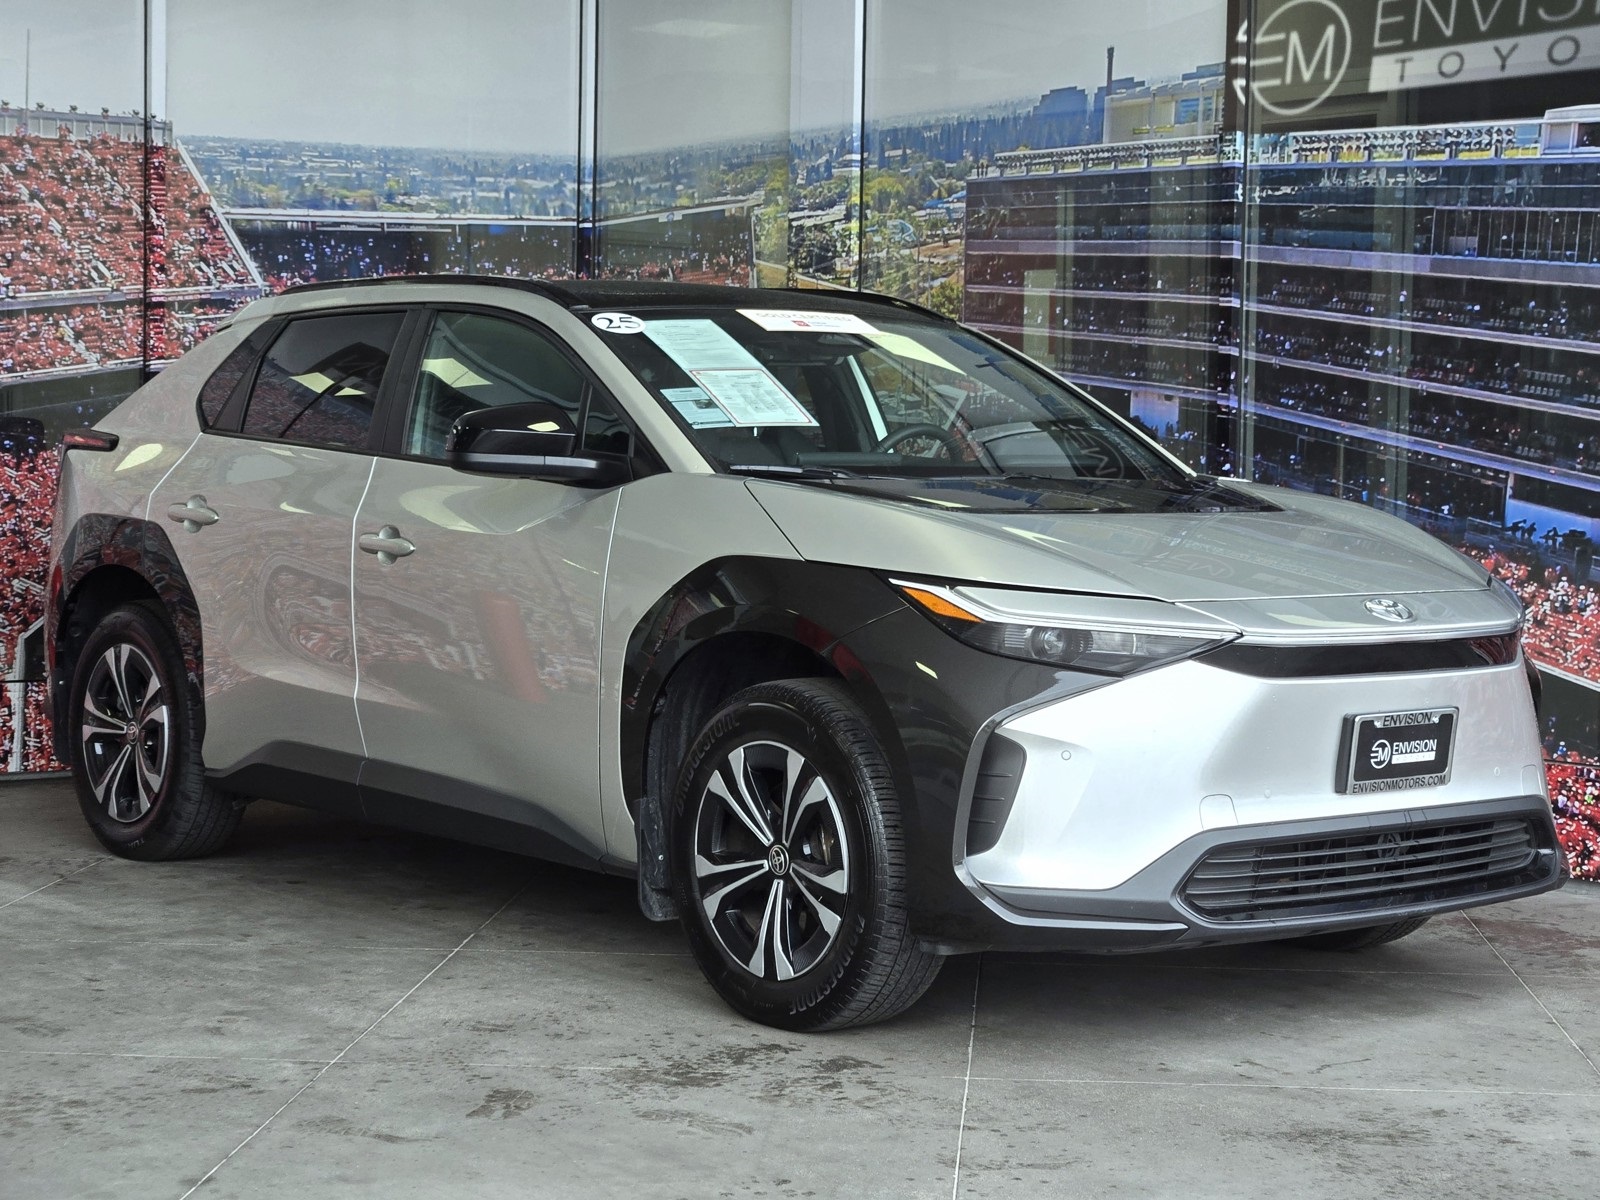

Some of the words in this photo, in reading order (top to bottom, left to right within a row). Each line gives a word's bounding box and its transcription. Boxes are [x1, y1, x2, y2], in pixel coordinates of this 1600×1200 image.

[1395, 35, 1581, 83] TOYO
[596, 316, 641, 329] 25
[1382, 712, 1433, 727] ENVISION
[1392, 739, 1437, 755] ENVISION
[1352, 775, 1446, 794] ENVISIONMOTORS.COM
